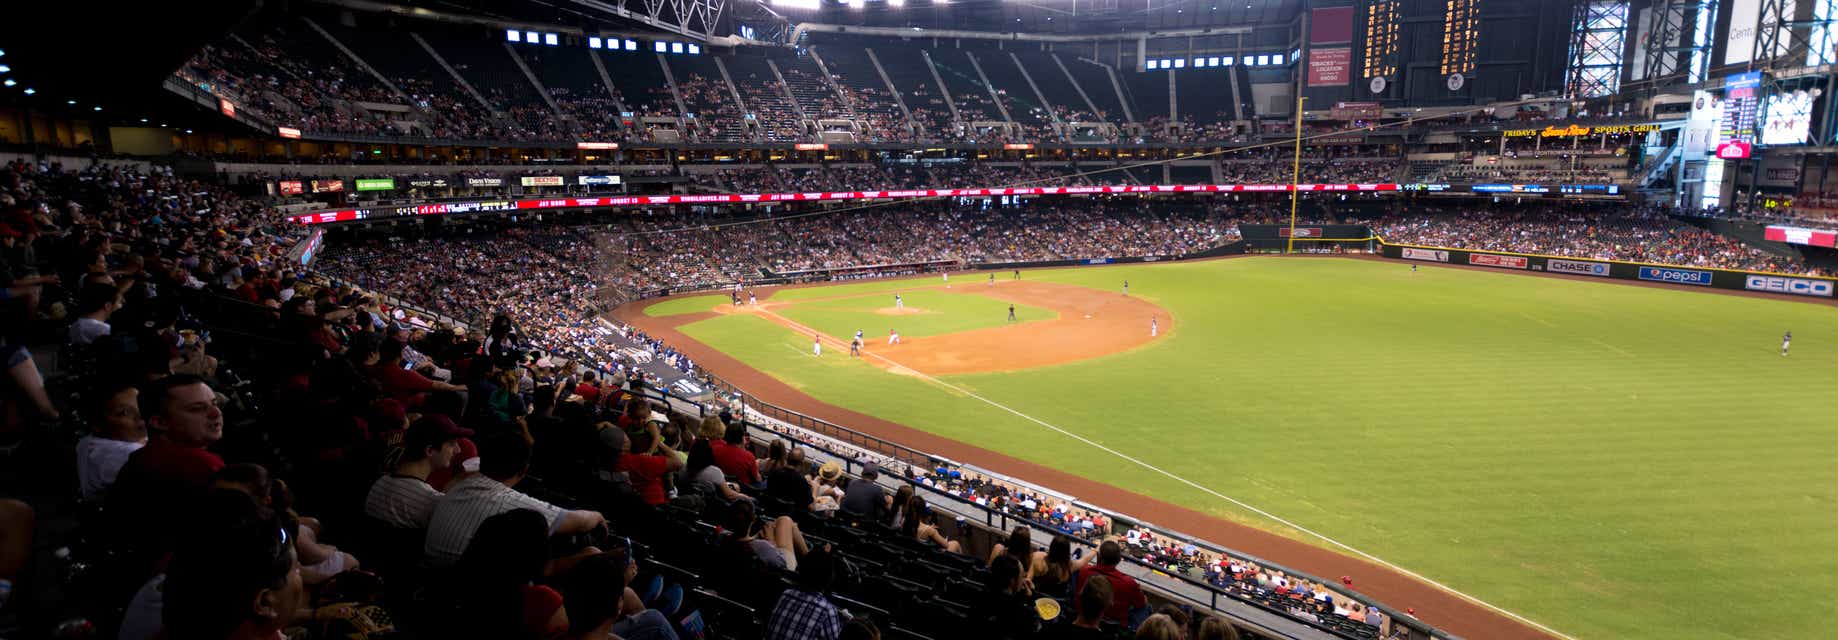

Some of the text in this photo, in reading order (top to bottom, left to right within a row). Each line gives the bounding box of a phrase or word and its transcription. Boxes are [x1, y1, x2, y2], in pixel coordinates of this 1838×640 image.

[1633, 124, 1661, 132] GRILL
[1552, 262, 1592, 272] CHASE
[1663, 271, 1701, 283] pepsi
[1746, 275, 1834, 296] GEICO
